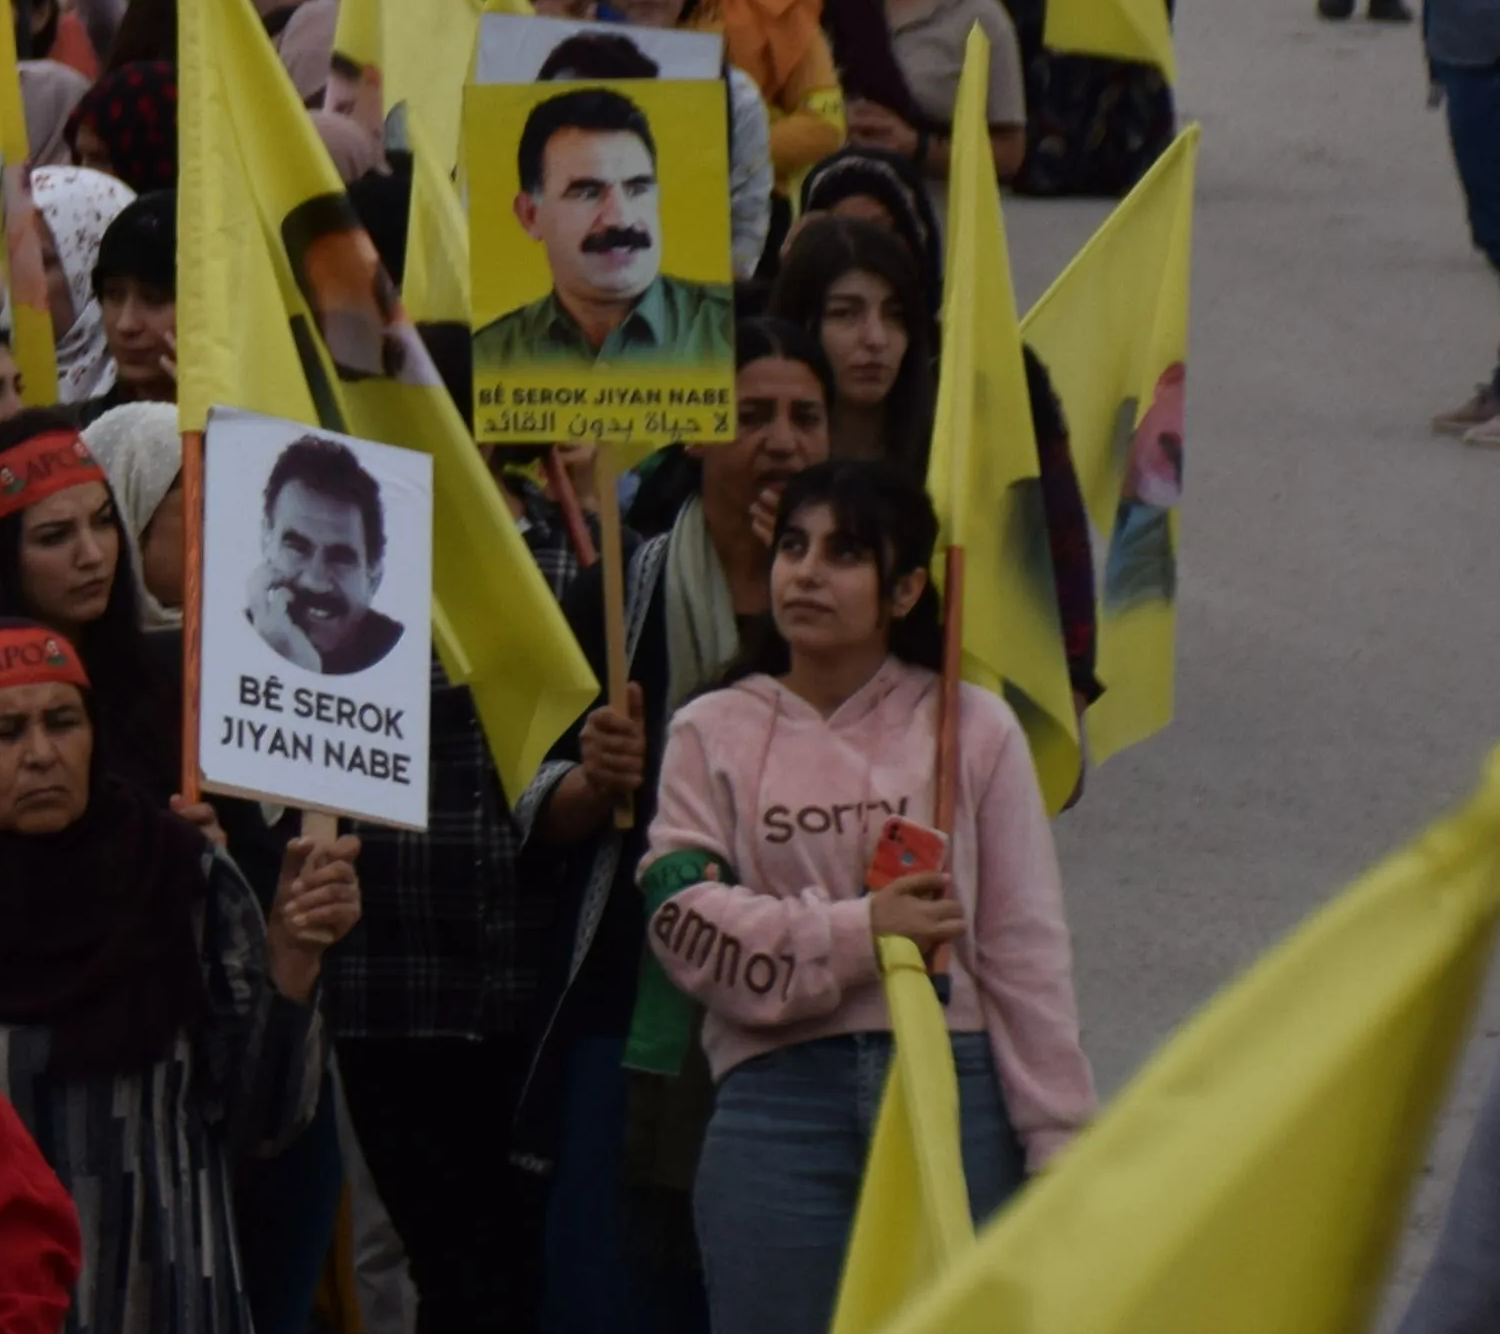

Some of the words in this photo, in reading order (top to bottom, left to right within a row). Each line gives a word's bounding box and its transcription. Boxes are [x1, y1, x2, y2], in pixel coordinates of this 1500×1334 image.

[478, 381, 506, 405] BÊ
[512, 387, 588, 405] SEROK
[594, 387, 661, 405] JIYAN
[668, 387, 729, 405] NABE
[482, 409, 556, 434] القائد
[568, 412, 634, 440] بدون
[645, 410, 703, 440] حياة
[713, 410, 728, 434] لا
[240, 675, 284, 712] BÊ
[293, 687, 404, 740] SEROK
[220, 715, 314, 762] JIYAN
[324, 738, 411, 785] NABE
